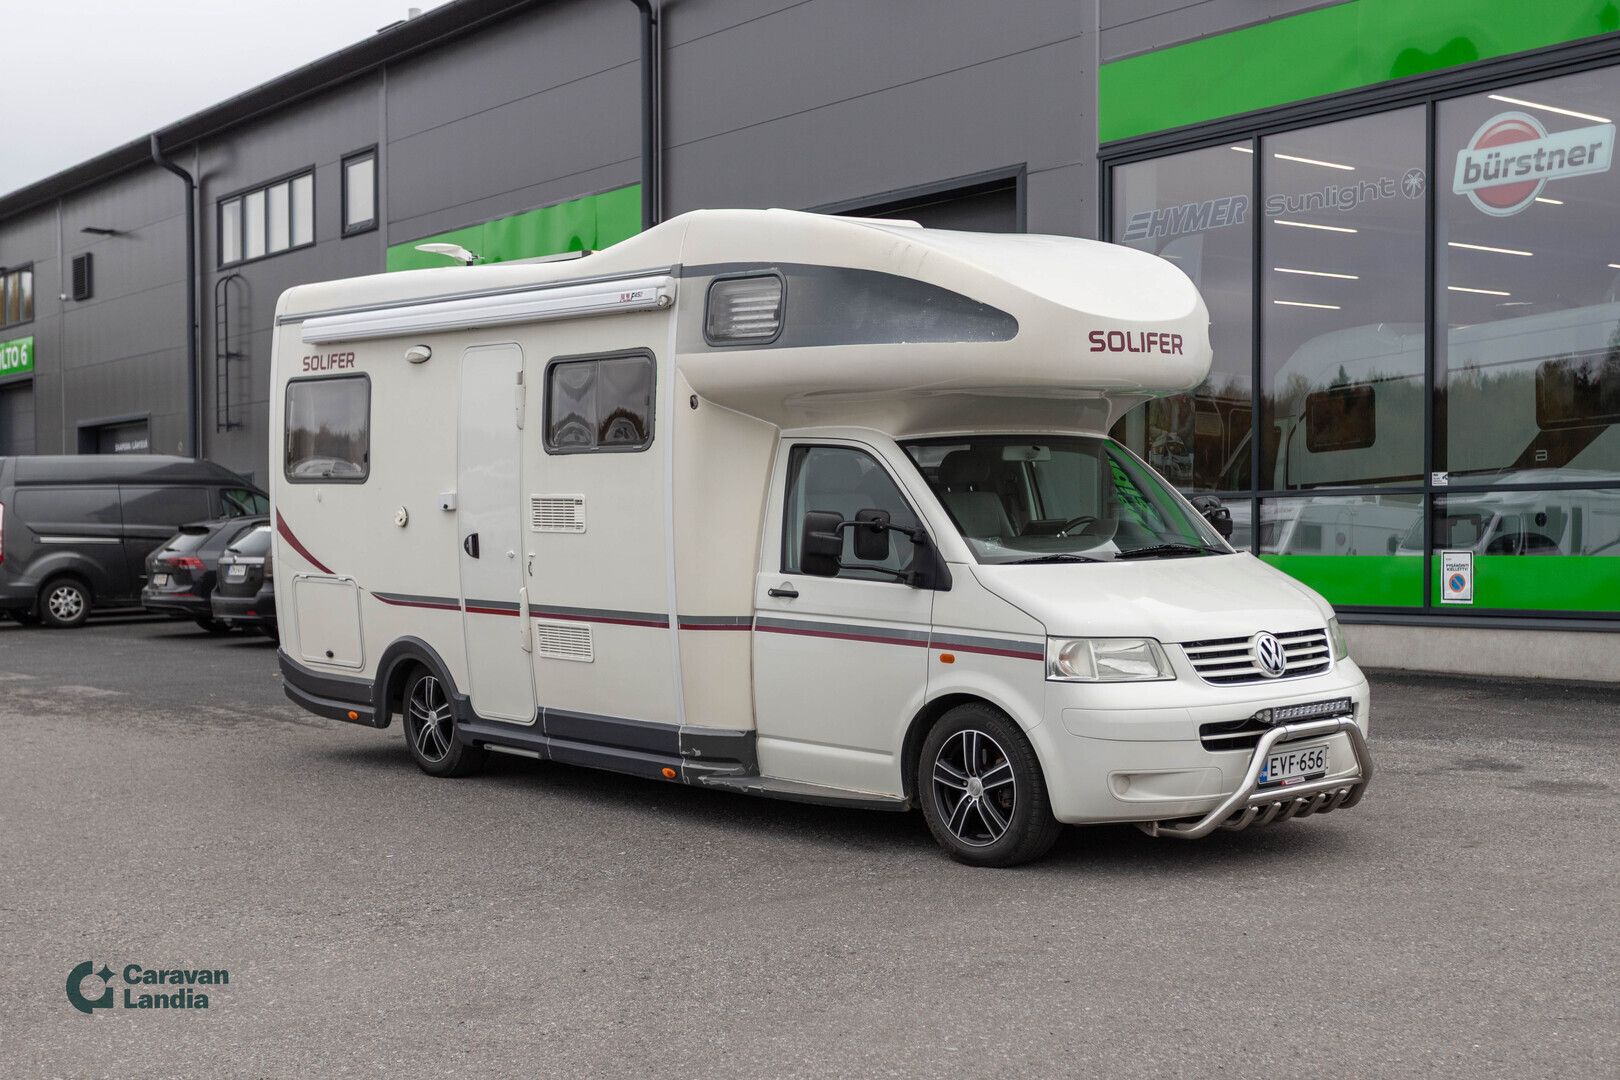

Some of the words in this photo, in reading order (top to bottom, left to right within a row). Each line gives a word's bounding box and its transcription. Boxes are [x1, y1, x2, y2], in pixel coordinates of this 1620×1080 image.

[1463, 141, 1603, 184] bürstner
[1265, 177, 1396, 217] Sunlight
[1144, 195, 1249, 239] HYMER
[1088, 330, 1183, 355] SOLIFER
[0, 345, 19, 370] LTO
[21, 343, 28, 366] 6
[302, 352, 355, 372] SOLIFER
[1270, 750, 1324, 777] EVF-656
